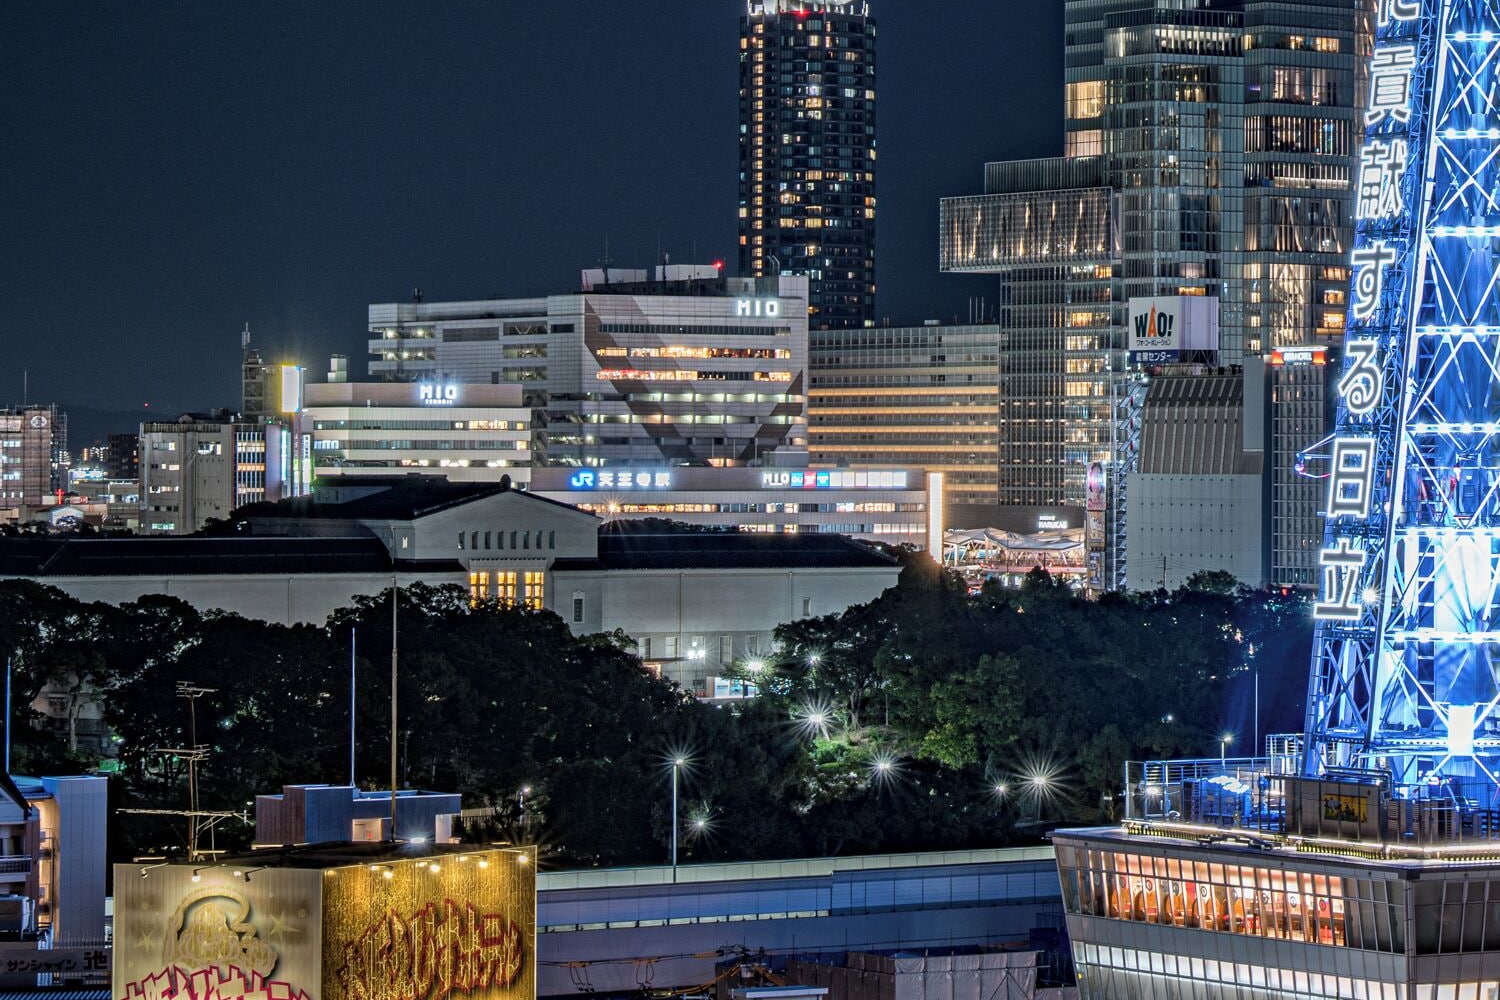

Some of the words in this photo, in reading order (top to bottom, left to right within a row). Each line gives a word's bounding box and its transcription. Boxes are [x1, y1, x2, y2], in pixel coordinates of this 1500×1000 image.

[737, 300, 778, 316] MIO
[1134, 300, 1174, 338] WAO!
[420, 385, 457, 399] MIO
[571, 473, 594, 487] JR
[7, 959, 77, 972] サンシャイン
